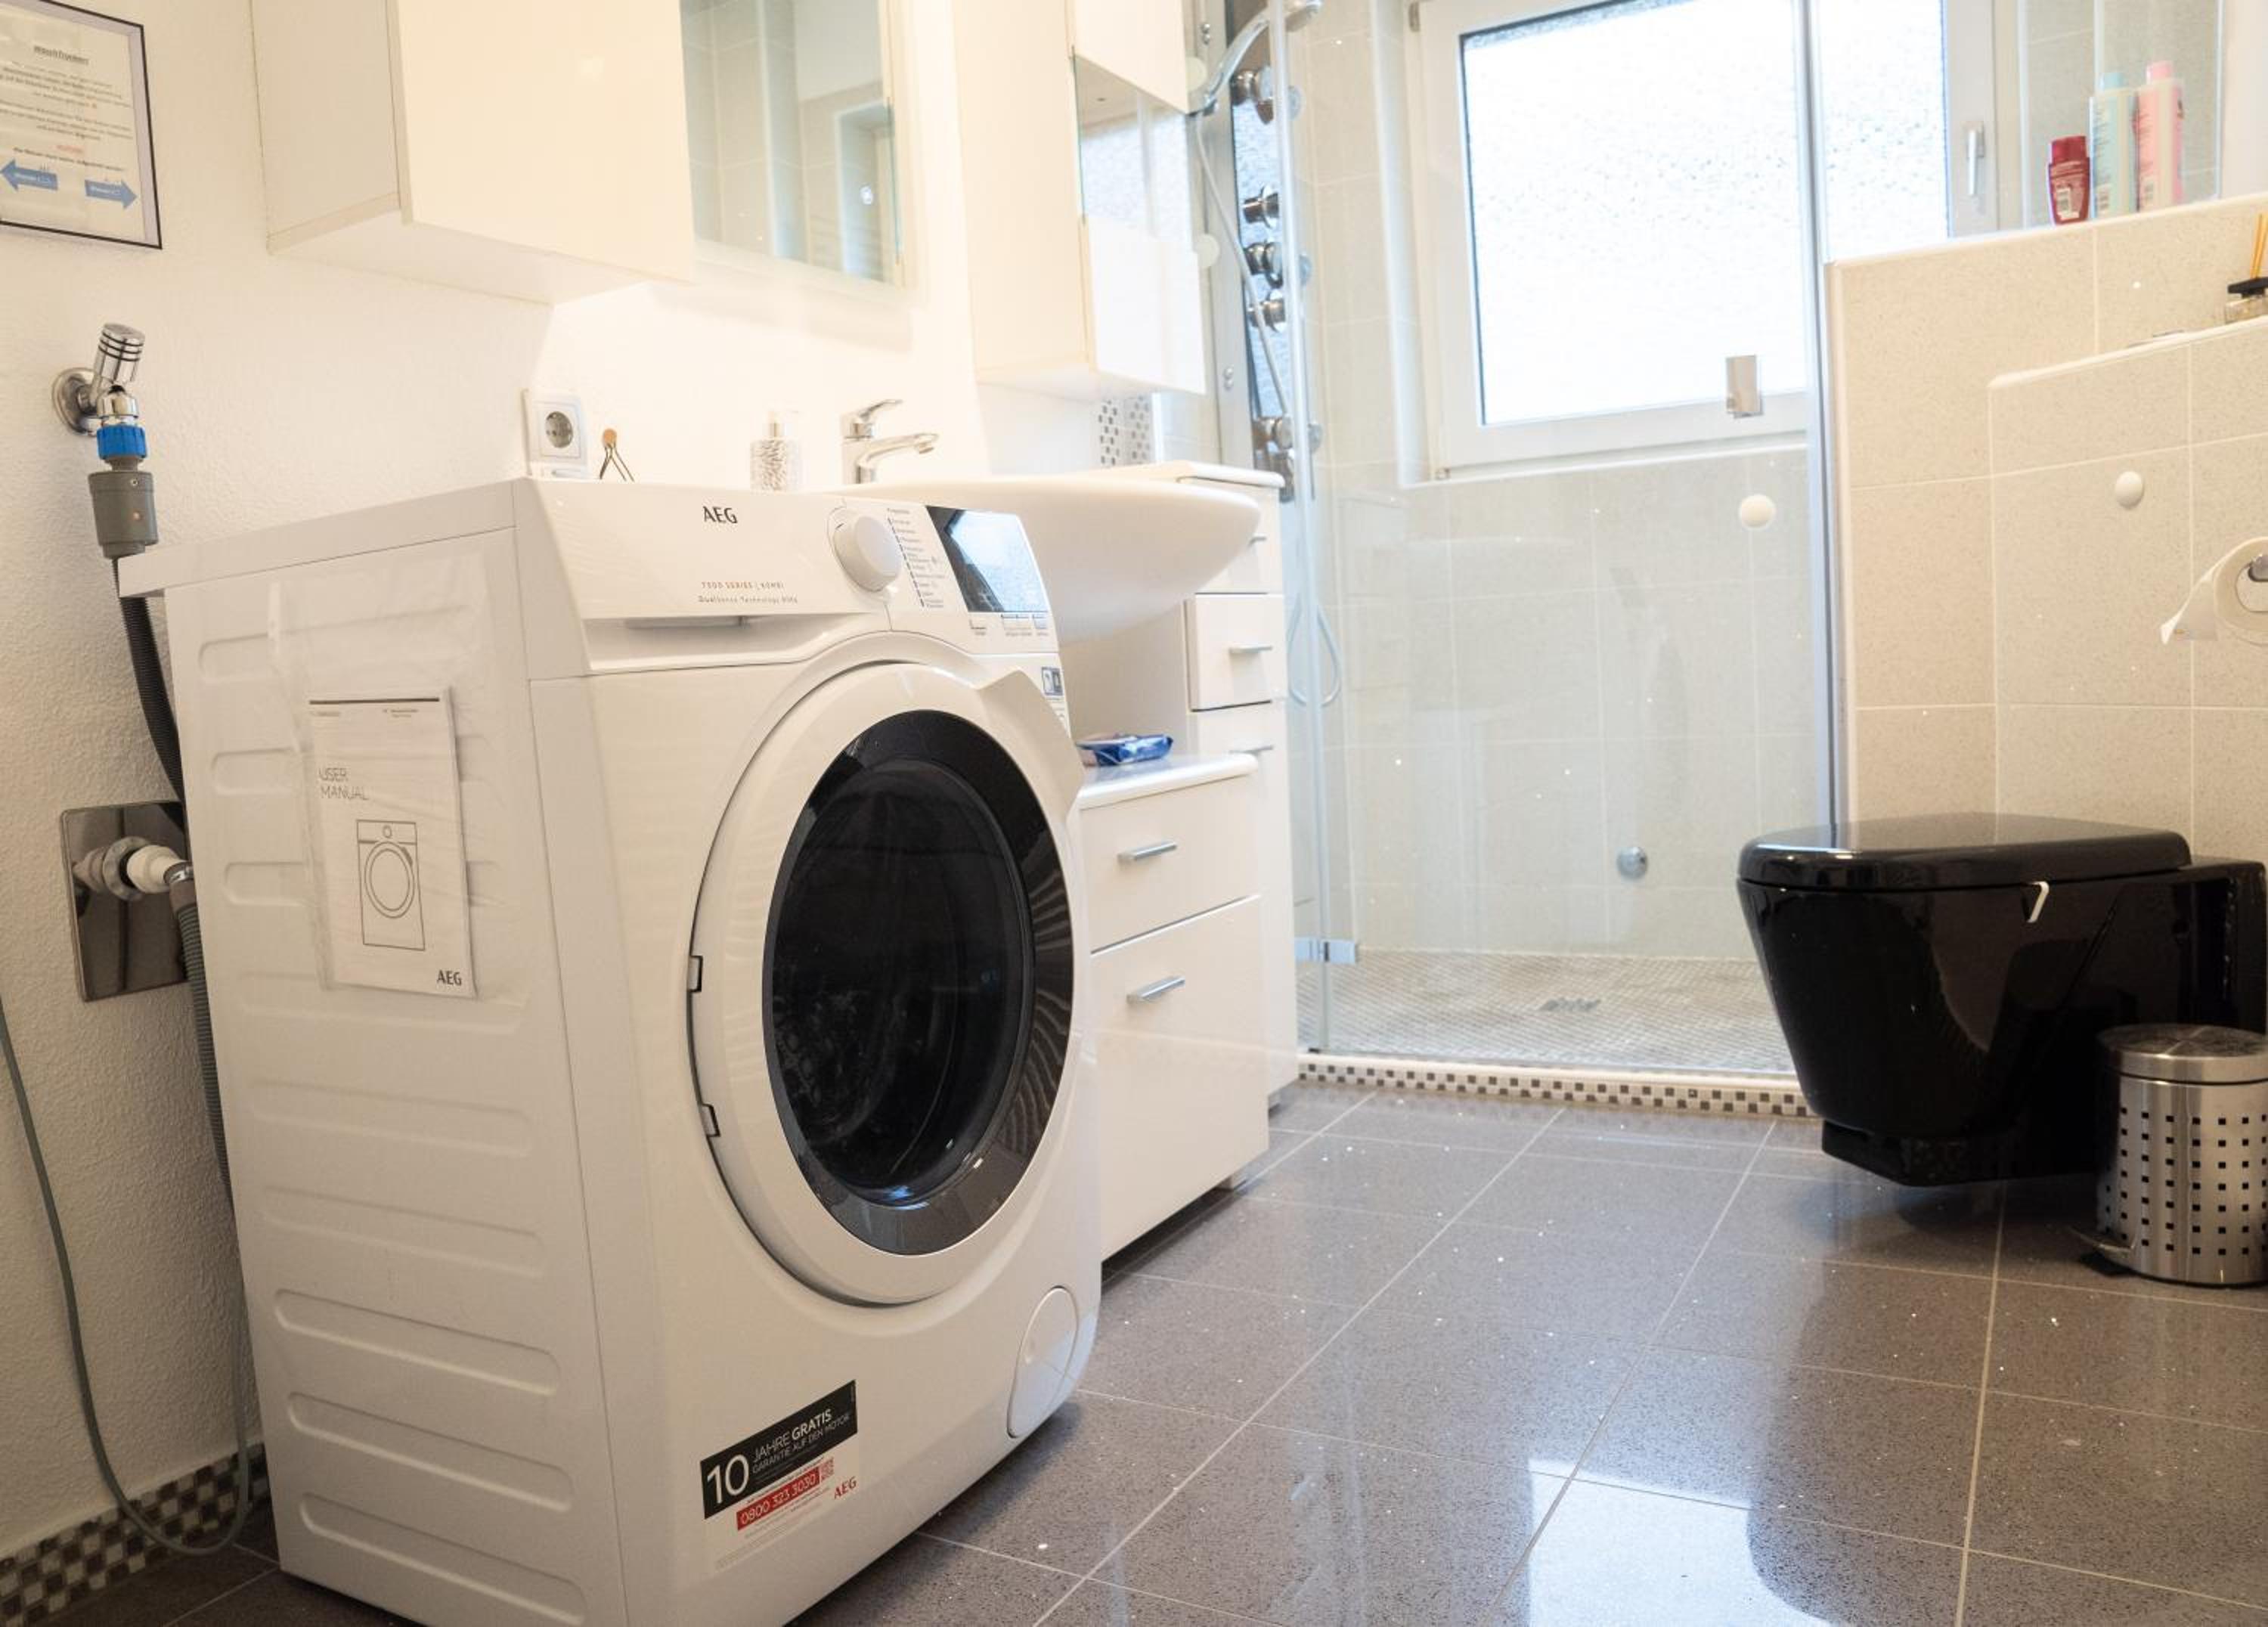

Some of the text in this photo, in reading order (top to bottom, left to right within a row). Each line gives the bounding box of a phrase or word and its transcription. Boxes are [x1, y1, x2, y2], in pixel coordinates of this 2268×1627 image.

[702, 505, 739, 524] AEG
[318, 767, 349, 783] USER
[320, 785, 370, 801] MANUAL
[435, 968, 462, 986] AEG
[706, 1454, 749, 1504] 10
[752, 1431, 791, 1463] JAHRE
[791, 1408, 832, 1441] GRATIS
[751, 1446, 792, 1474] GARANTIE
[833, 1476, 858, 1500] AEG
[740, 1499, 771, 1525] 0800
